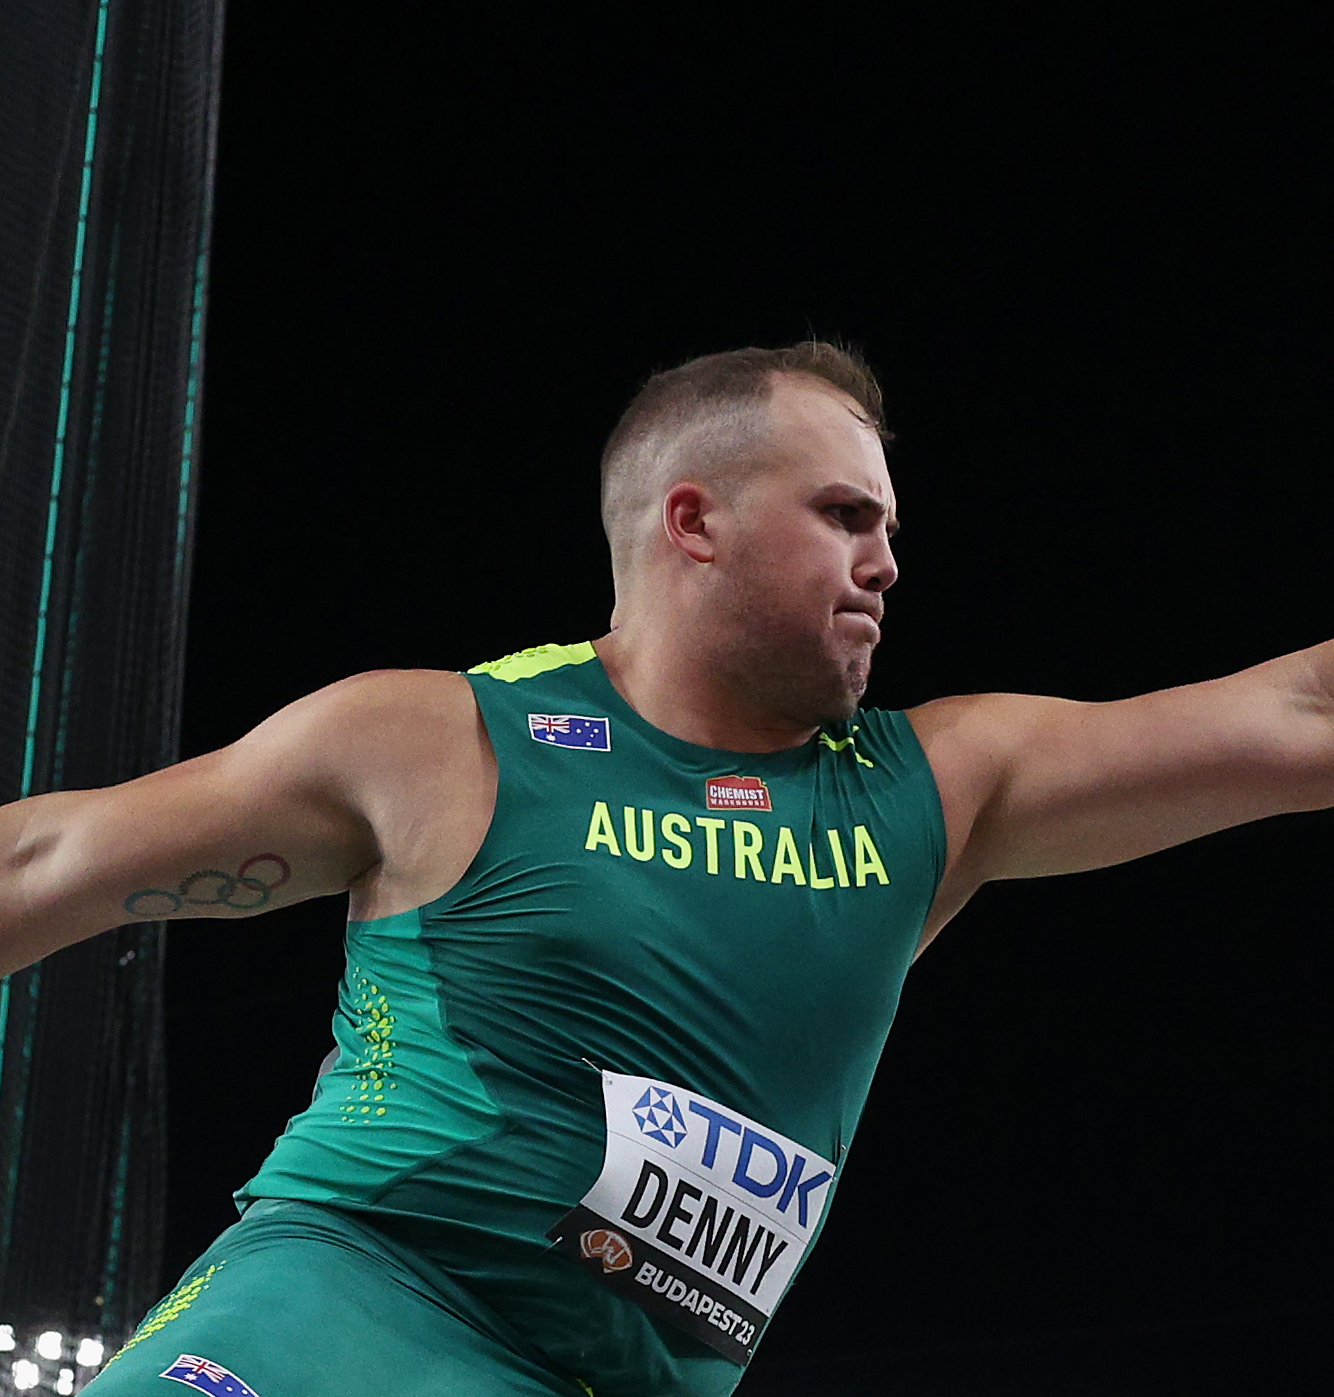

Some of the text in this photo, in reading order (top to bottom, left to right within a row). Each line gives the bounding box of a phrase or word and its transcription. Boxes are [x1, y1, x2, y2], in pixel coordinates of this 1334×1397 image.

[584, 801, 889, 888] AUSTRALIA
[709, 785, 764, 800] CHEMIST
[688, 1099, 831, 1229] TDK
[621, 1159, 788, 1295] DENNY
